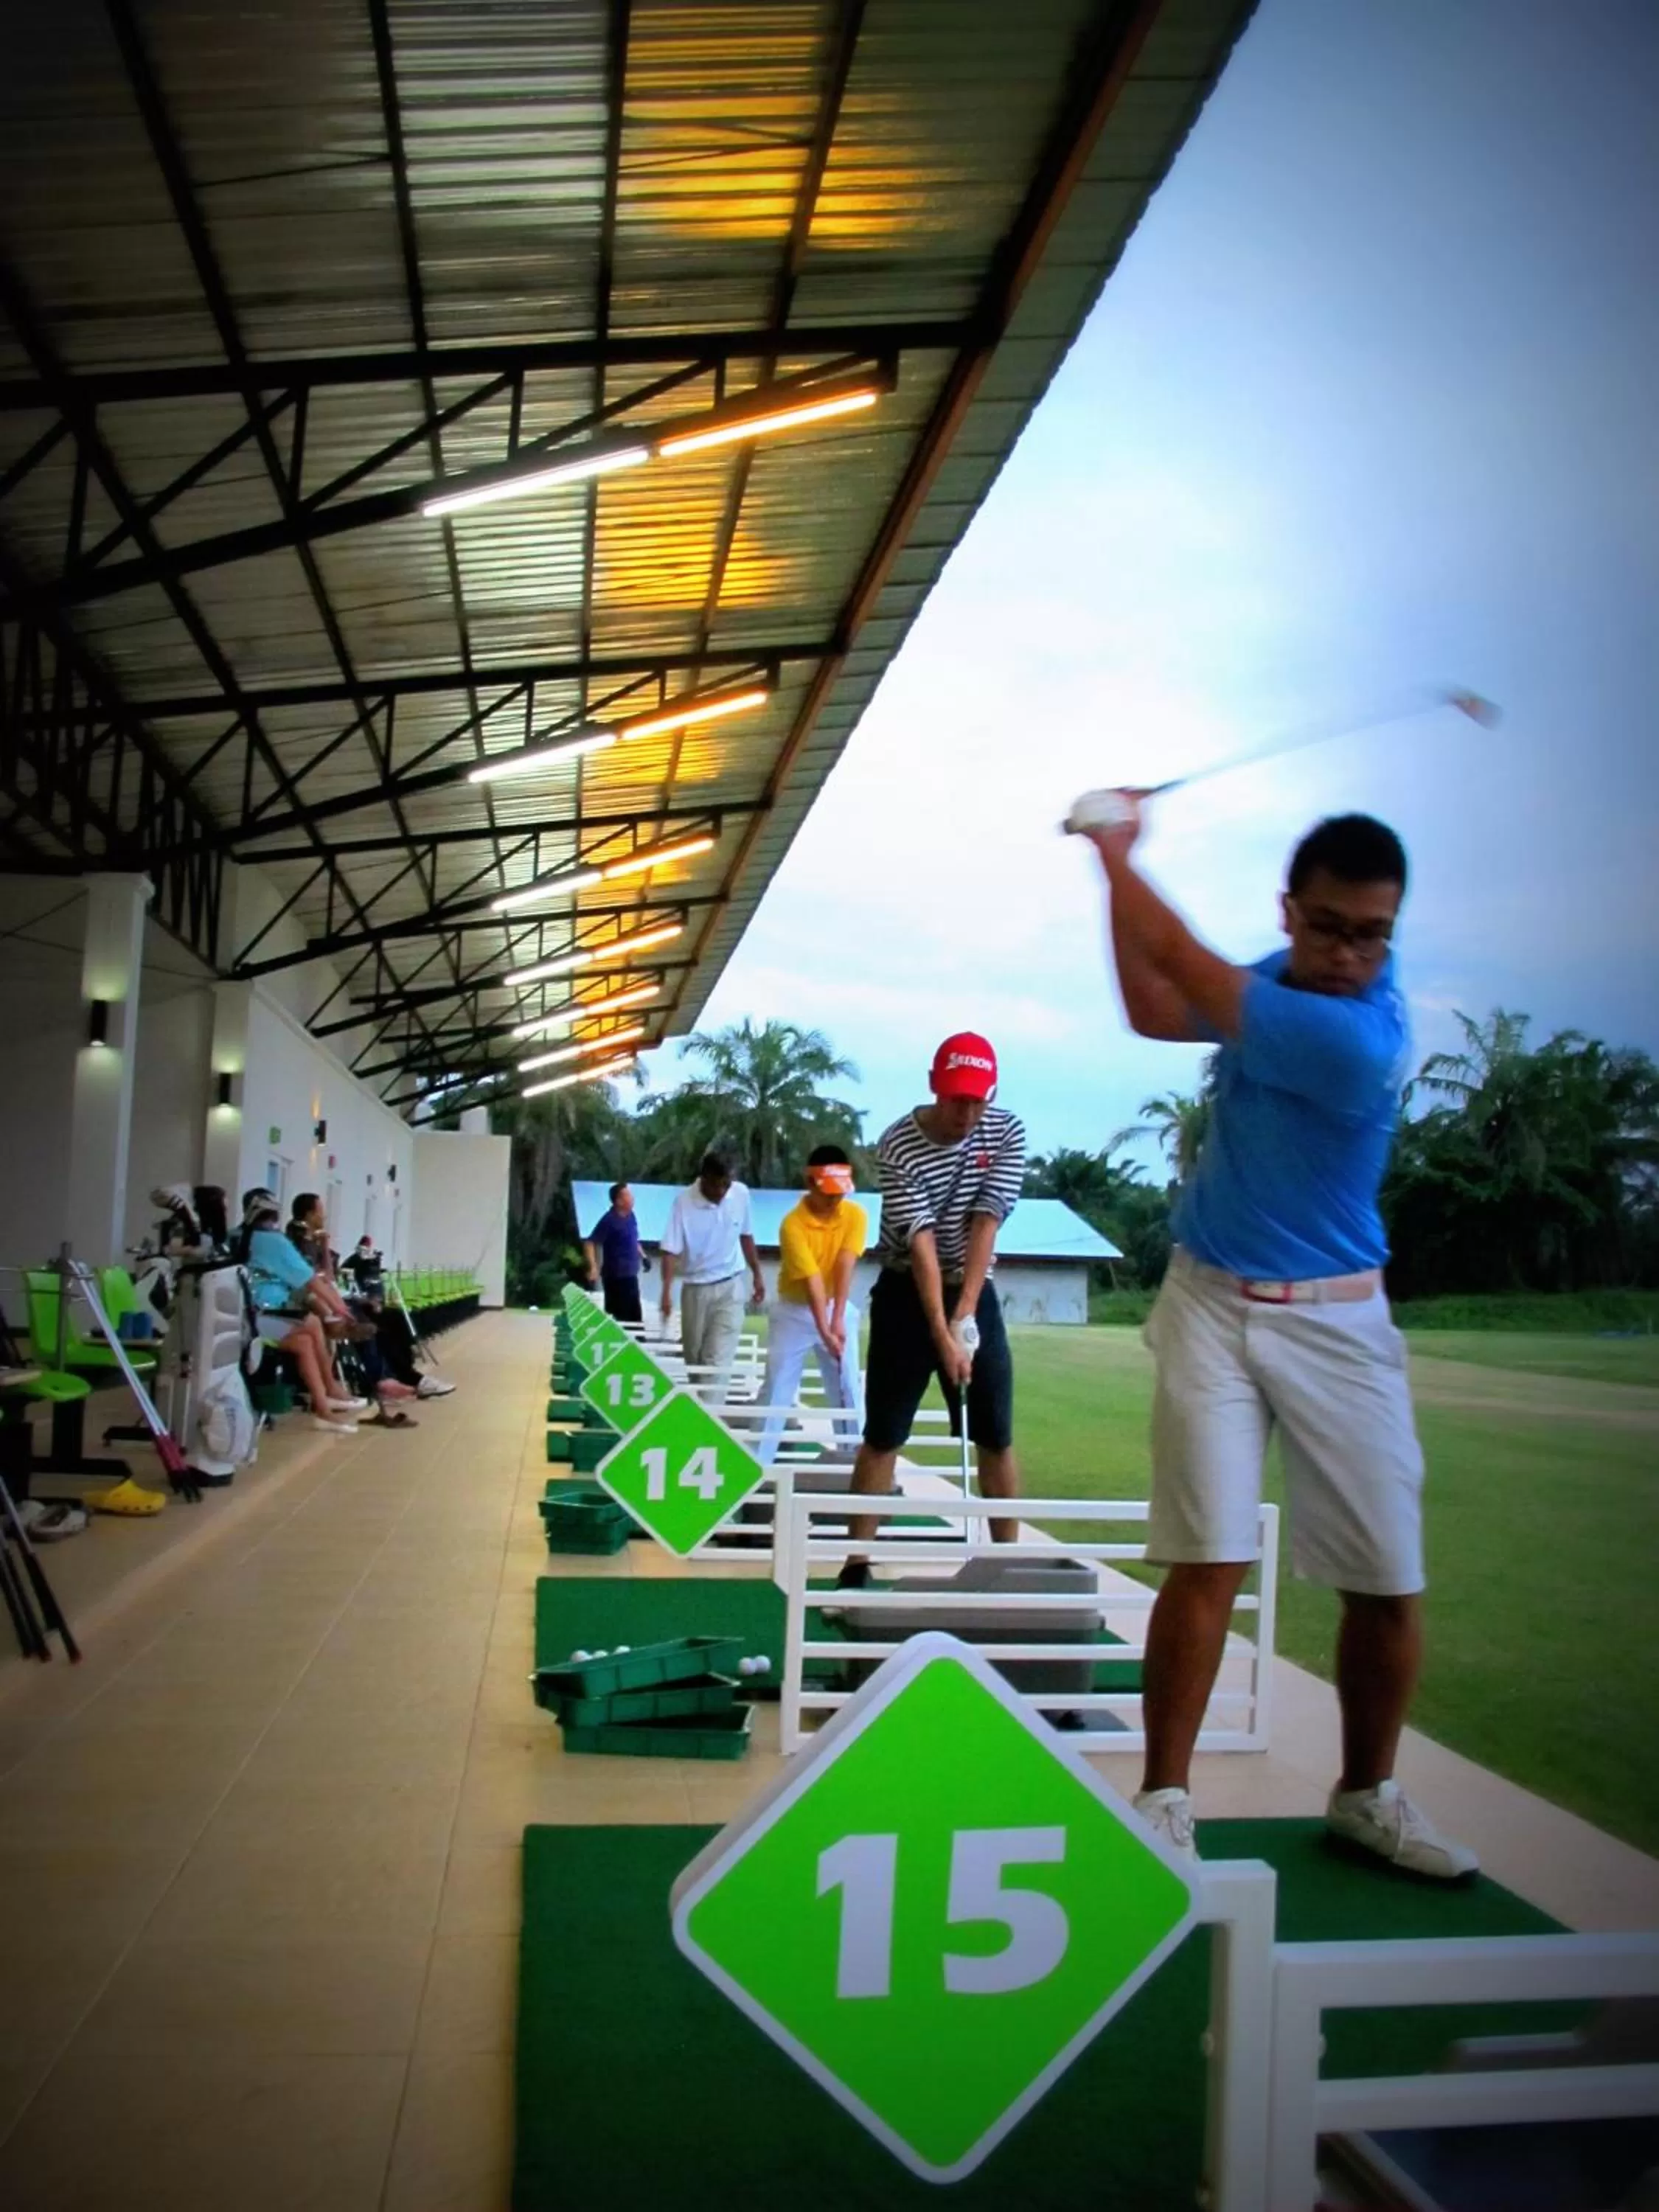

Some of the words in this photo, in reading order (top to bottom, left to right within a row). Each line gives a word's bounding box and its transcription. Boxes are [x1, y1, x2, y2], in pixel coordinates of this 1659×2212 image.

[605, 1374, 655, 1406] 13
[640, 1446, 725, 1501] 14
[815, 1826, 1069, 1999] 15
